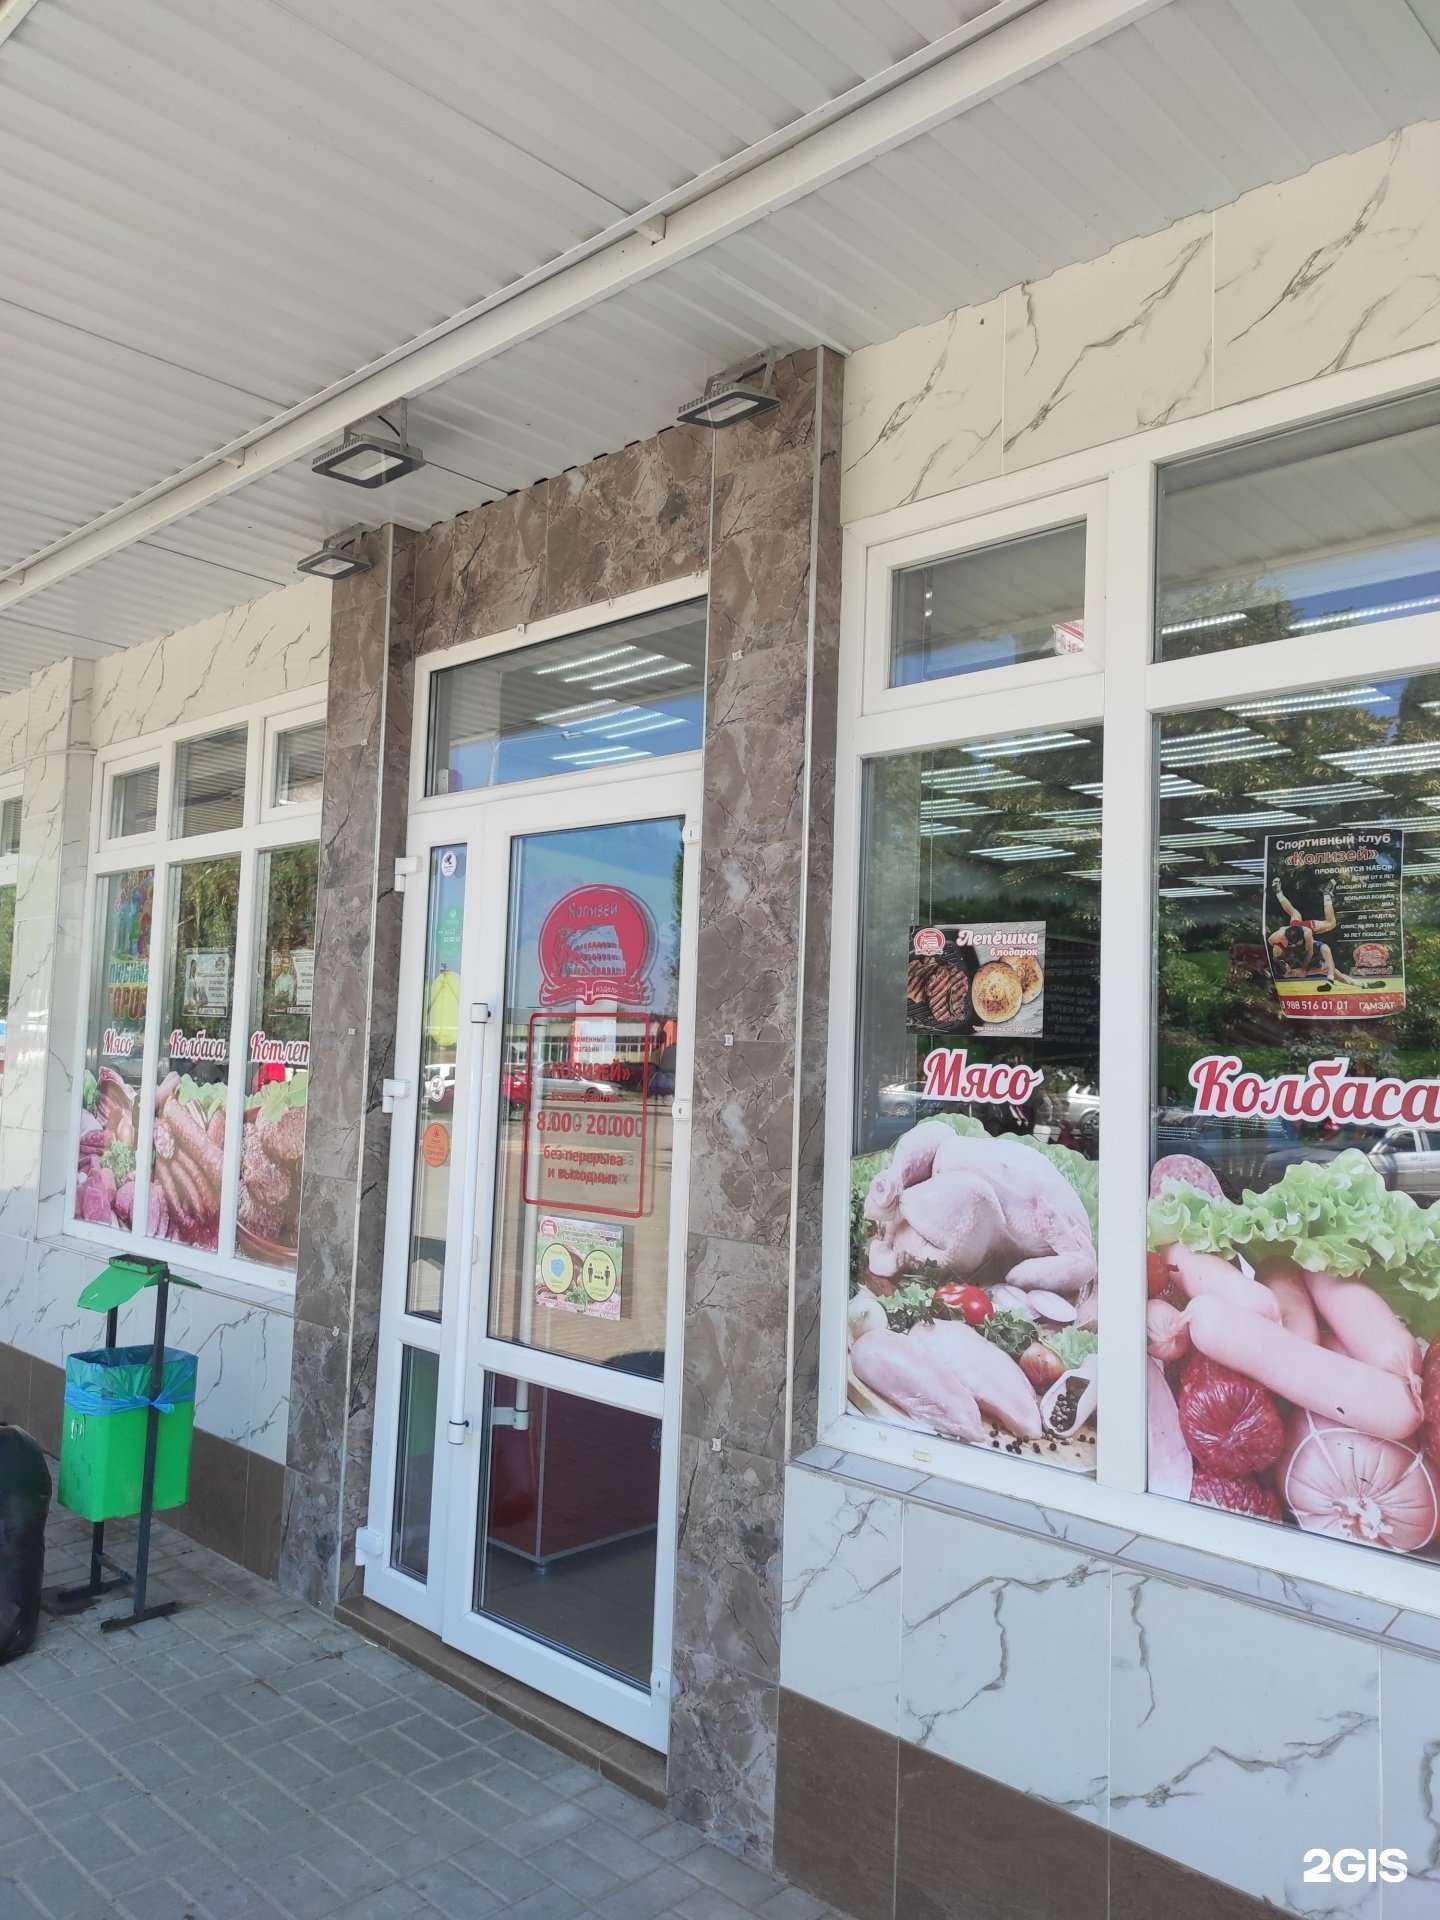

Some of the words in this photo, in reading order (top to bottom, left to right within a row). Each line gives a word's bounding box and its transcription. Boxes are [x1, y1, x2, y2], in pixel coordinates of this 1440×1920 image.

[1276, 833, 1355, 850] Спортивный
[1358, 833, 1391, 846] клуб
[956, 930, 1038, 946] Лепёшка
[997, 948, 1038, 957] подарок
[1302, 1000, 1319, 1010] 516
[1321, 1000, 1333, 1010] 01
[1336, 1000, 1348, 1010] 01
[1359, 1001, 1395, 1010] ГАМЗАТ
[103, 1029, 134, 1056] Мясо
[170, 1030, 226, 1059] Колбаса
[925, 1050, 1041, 1103] Мясо
[1190, 1058, 1440, 1126] Колбаса
